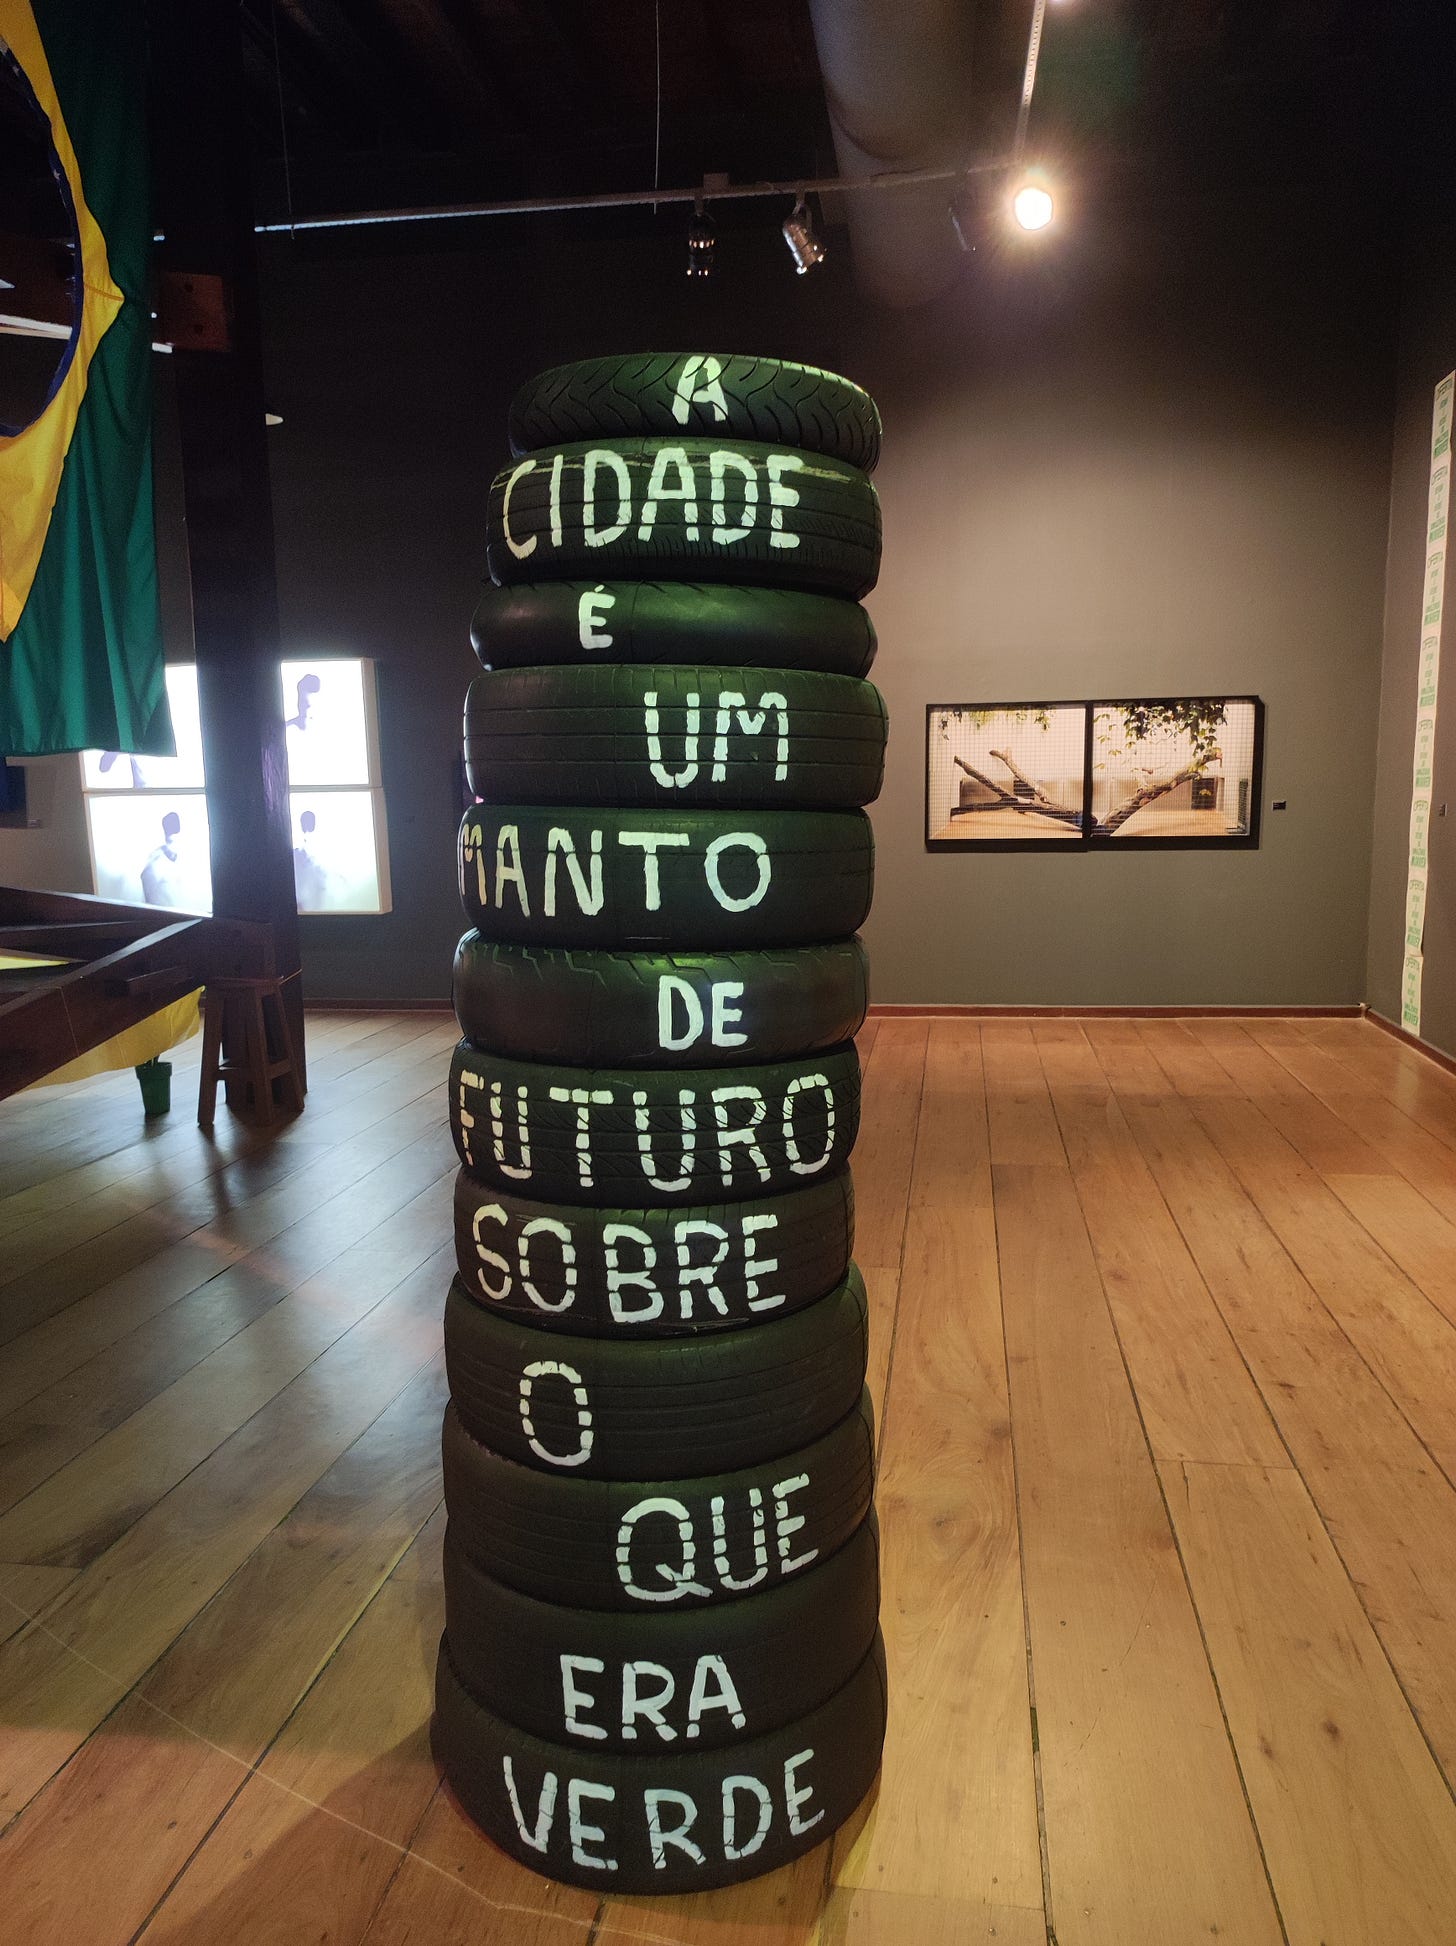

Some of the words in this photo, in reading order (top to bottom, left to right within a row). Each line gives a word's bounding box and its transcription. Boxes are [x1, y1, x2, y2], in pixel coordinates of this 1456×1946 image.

[671, 355, 729, 425] A
[503, 447, 804, 559] CIDADE
[578, 584, 616, 650] É
[643, 690, 789, 789] UM
[459, 824, 771, 917] MANTO
[657, 974, 749, 1051] DE
[459, 1073, 835, 1191] FUTURO
[472, 1203, 786, 1323] SOBRE
[519, 1360, 594, 1467] O
[615, 1472, 819, 1602] QUE
[559, 1654, 747, 1742] ERA
[502, 1748, 825, 1871] VERDE
